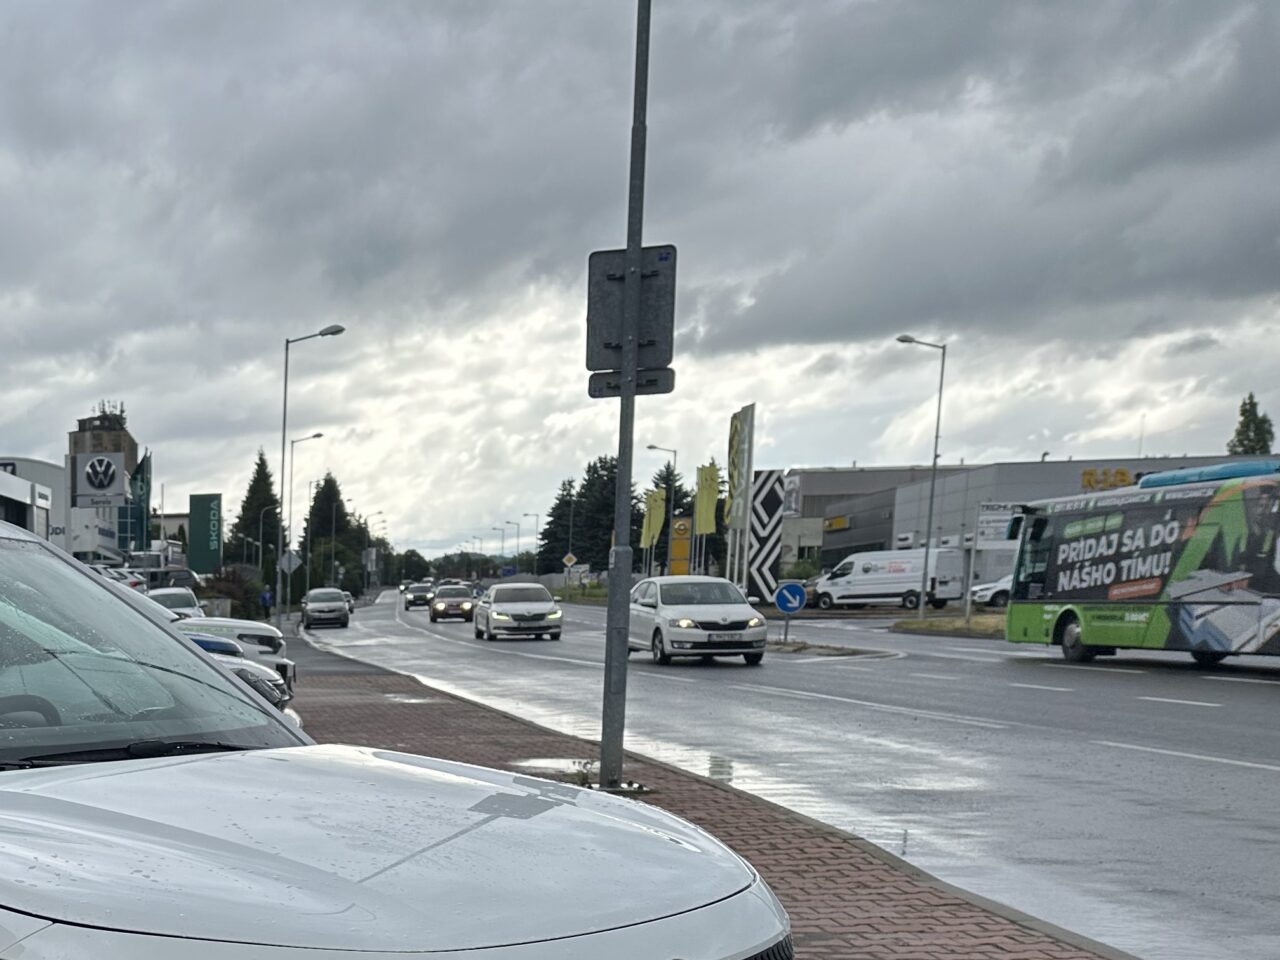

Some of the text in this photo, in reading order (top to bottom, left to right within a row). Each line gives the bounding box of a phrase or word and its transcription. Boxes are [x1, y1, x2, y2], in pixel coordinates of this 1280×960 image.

[1121, 527, 1145, 553] SA
[1057, 561, 1117, 592] NÁŠHO
[1120, 551, 1172, 581] TÍMU!
